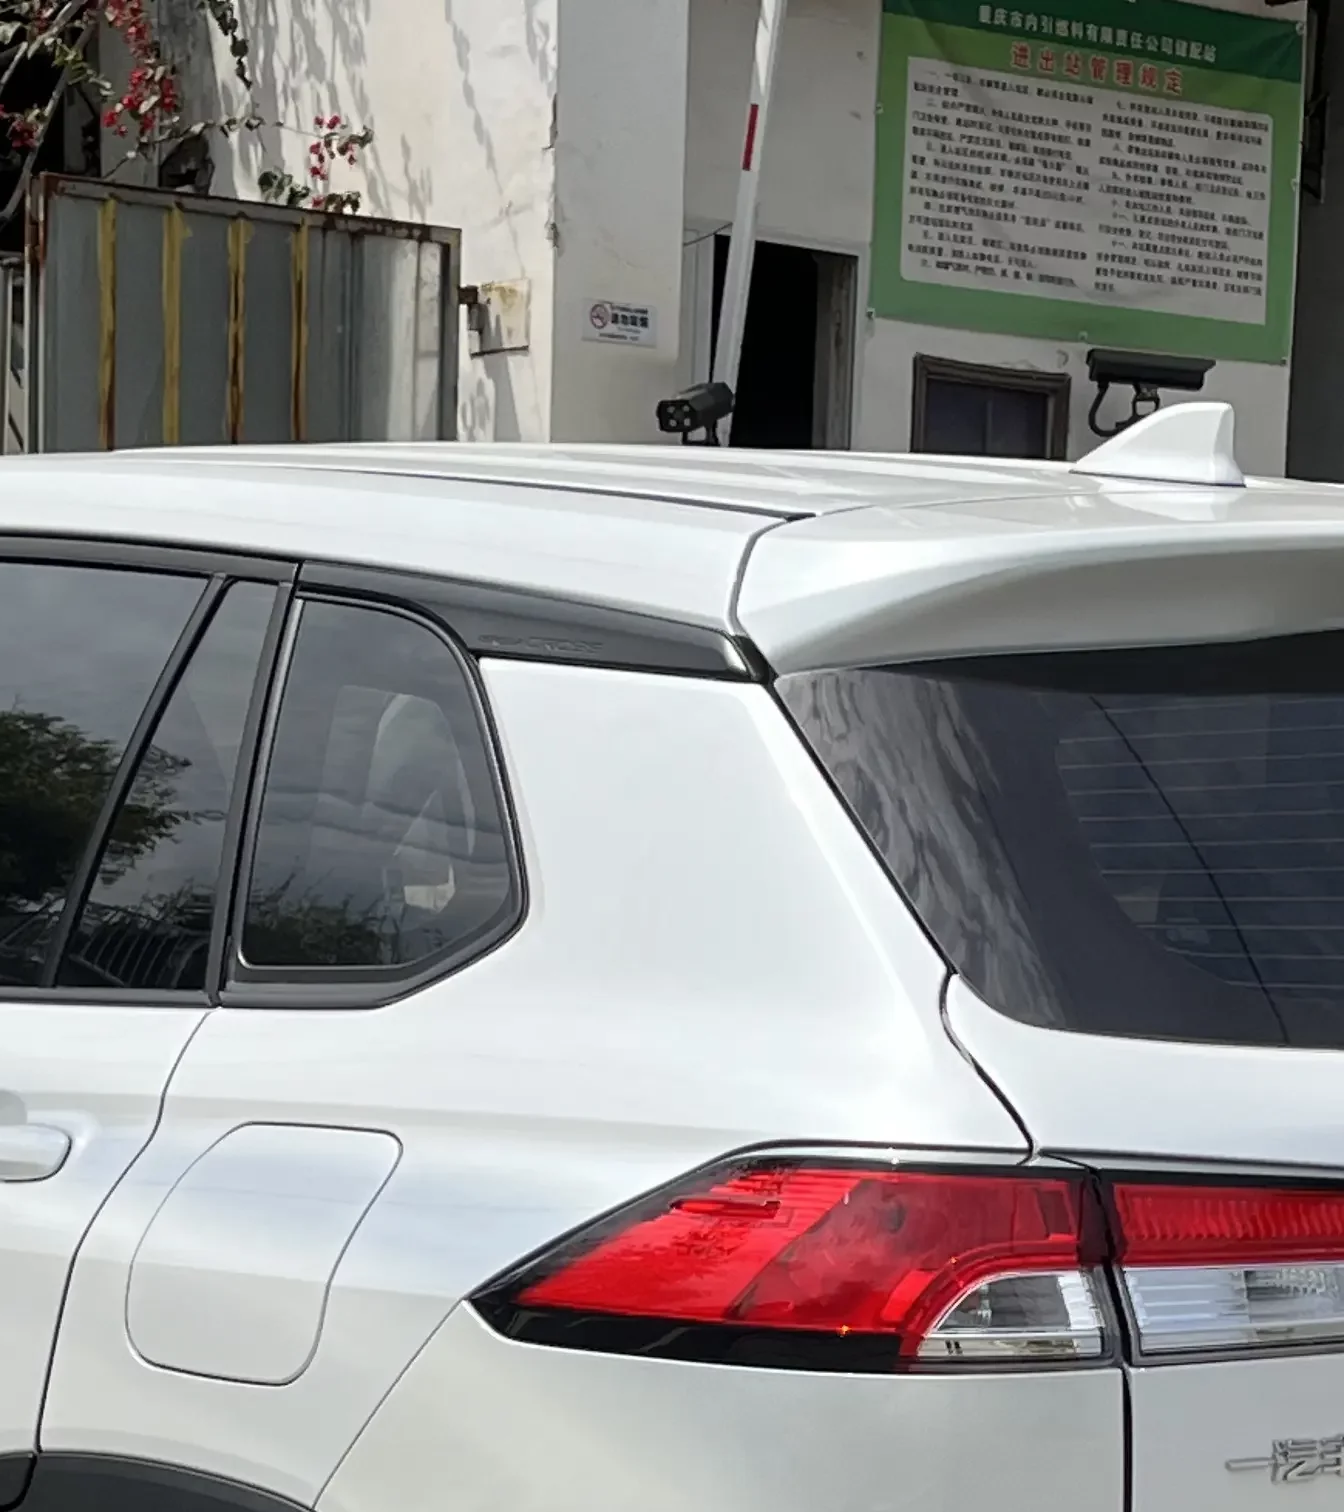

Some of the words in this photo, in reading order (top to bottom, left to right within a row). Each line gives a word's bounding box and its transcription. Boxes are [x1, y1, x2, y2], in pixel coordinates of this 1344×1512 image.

[1011, 41, 1186, 96] 进出站管理规定
